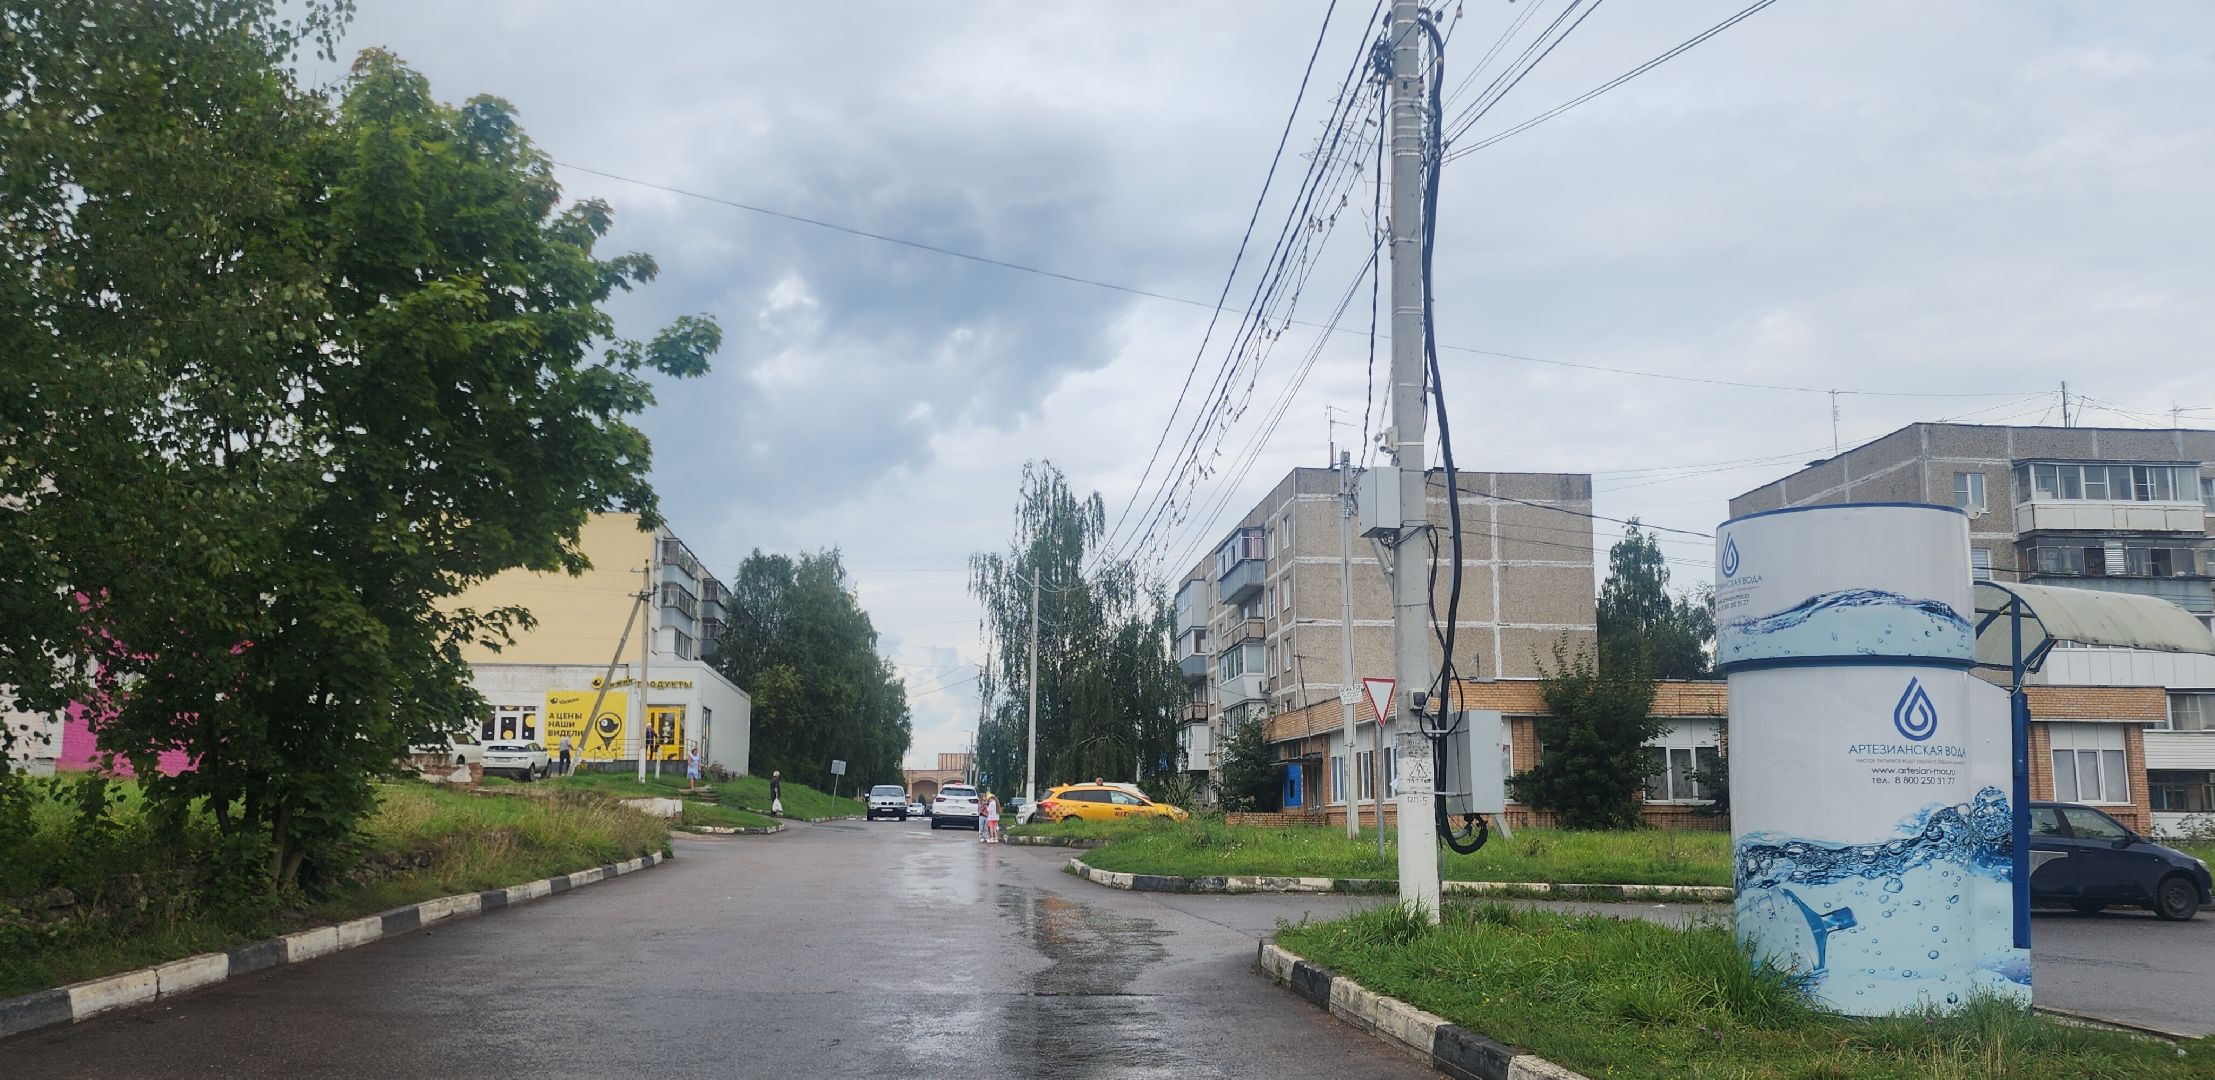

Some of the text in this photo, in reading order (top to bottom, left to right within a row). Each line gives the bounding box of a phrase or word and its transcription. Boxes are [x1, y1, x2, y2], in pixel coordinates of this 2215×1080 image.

[1848, 744, 1967, 758] АРТЕЗИАНСКАЯ ВОДА
[1903, 777, 1919, 785] 800
[1921, 777, 1935, 785] 250
[1937, 777, 1946, 785] 31
